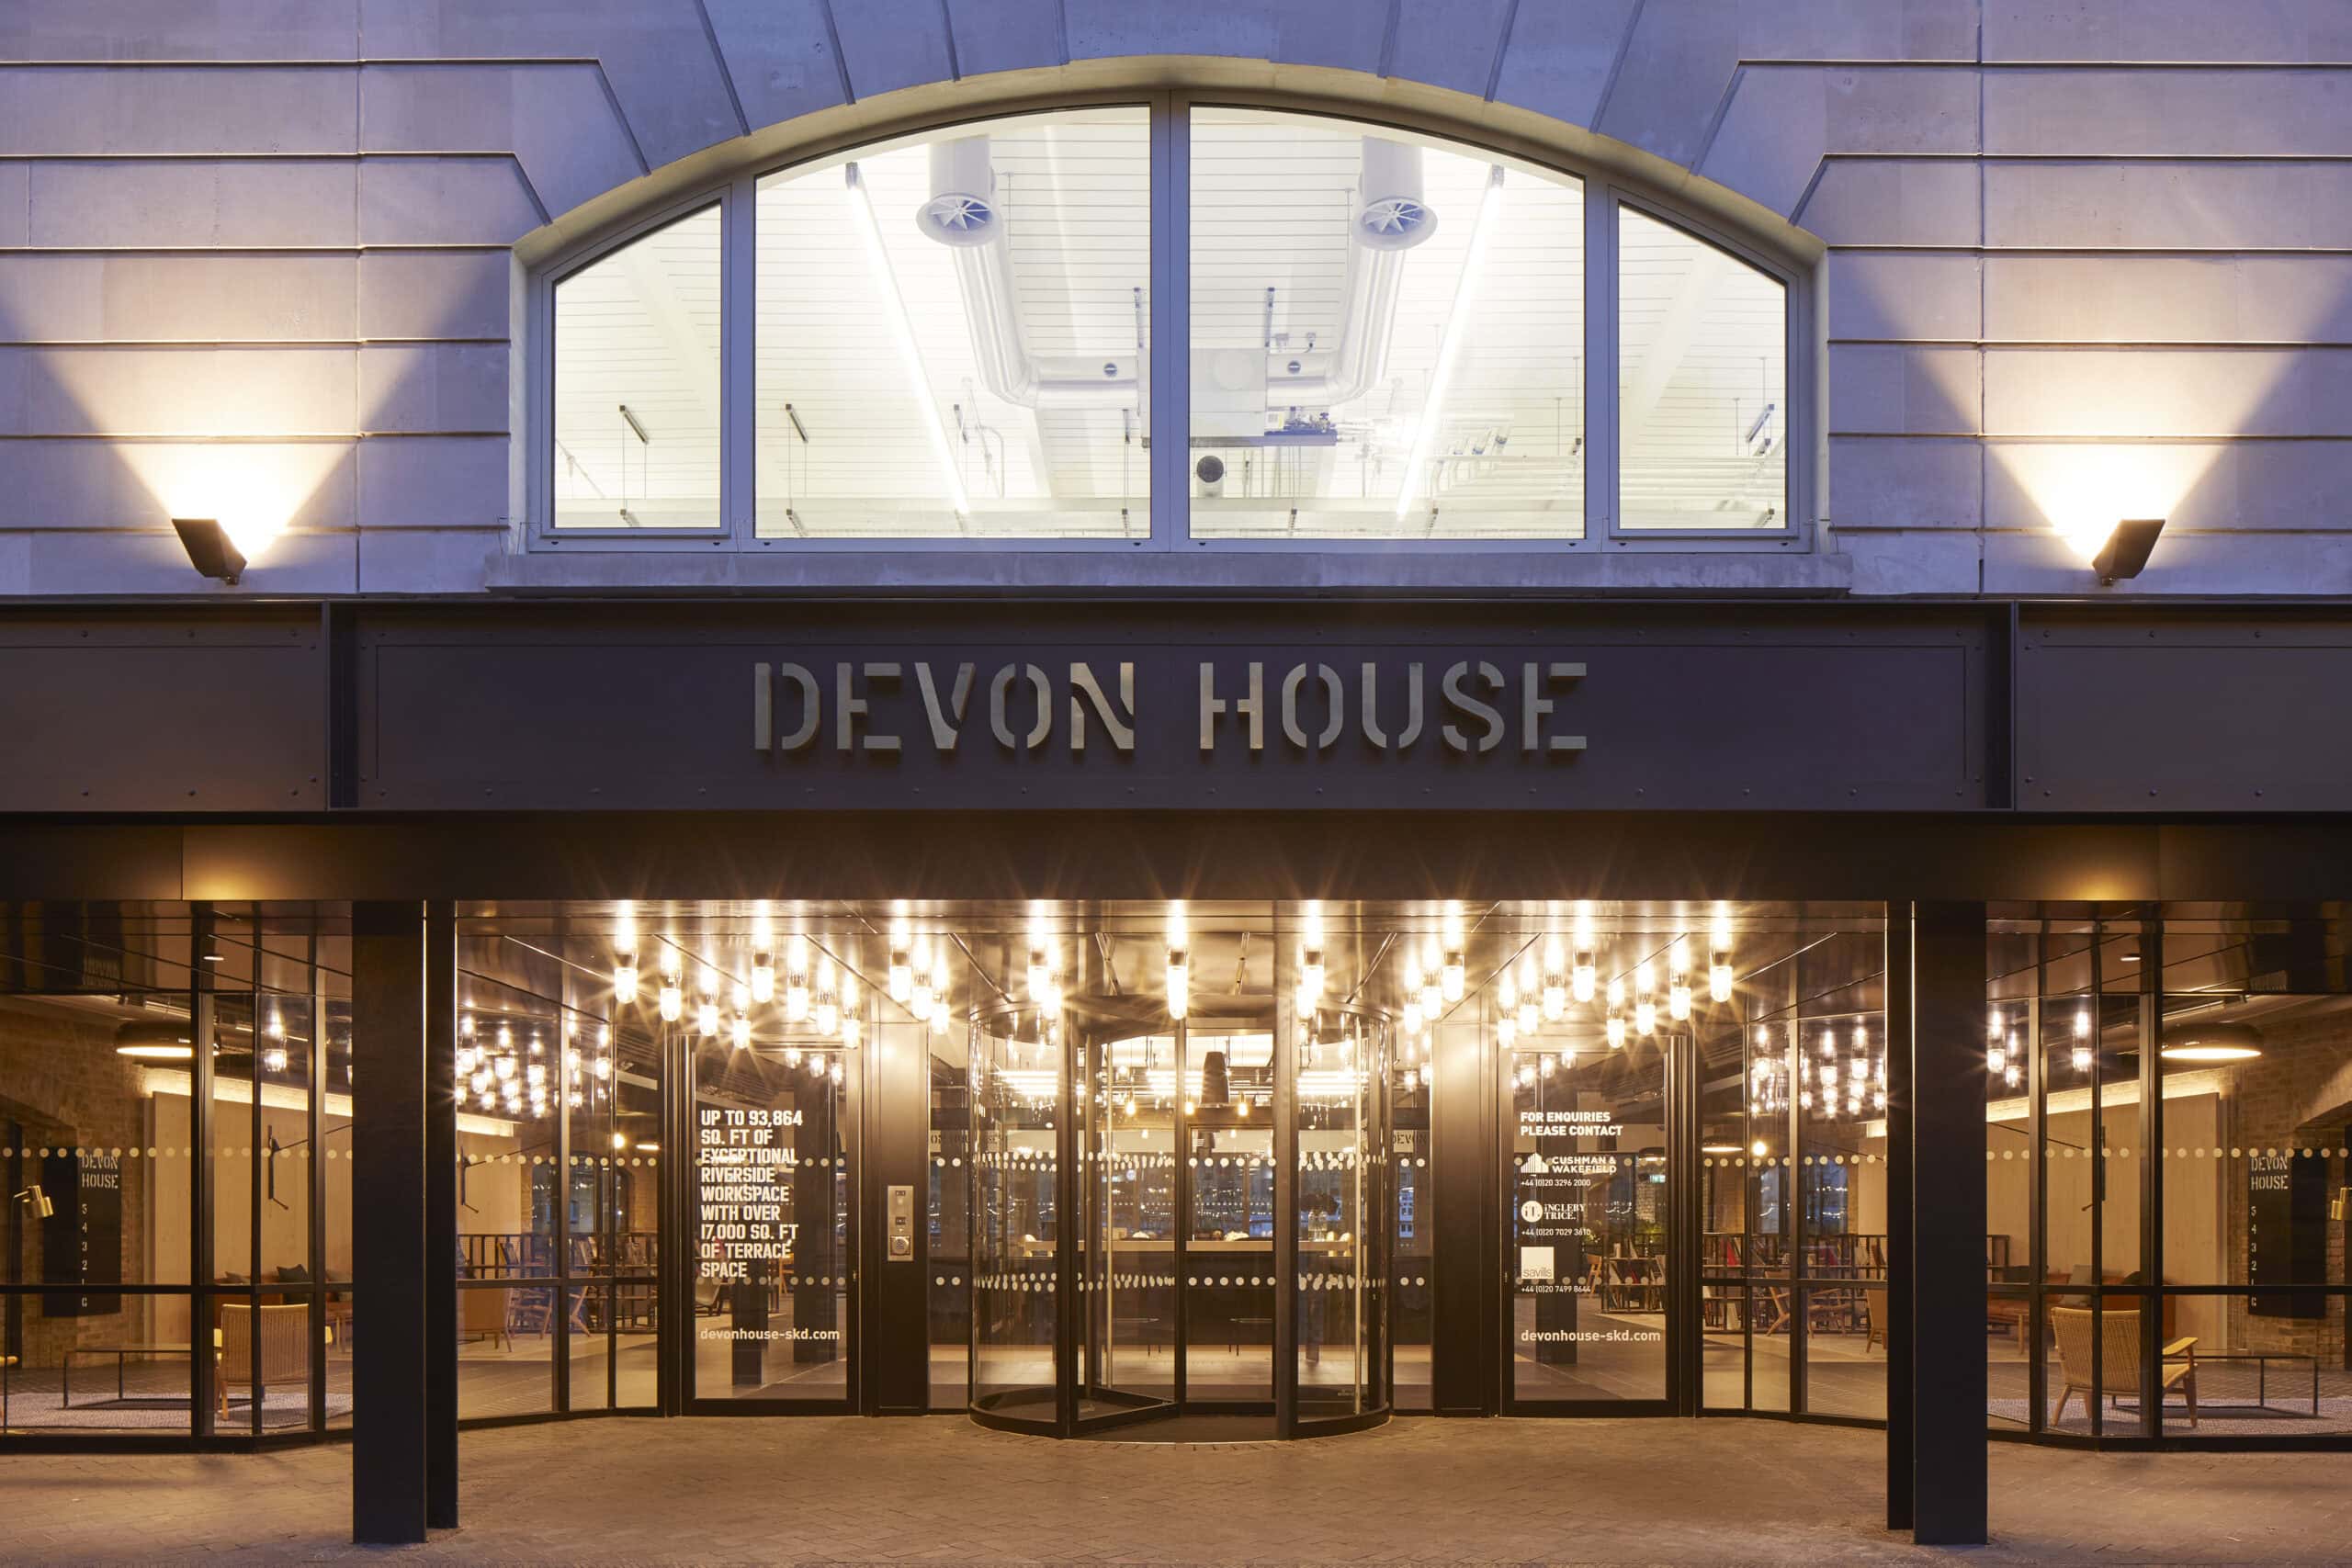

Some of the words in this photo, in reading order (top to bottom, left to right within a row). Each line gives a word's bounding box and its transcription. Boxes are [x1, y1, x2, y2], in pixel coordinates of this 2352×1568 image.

[752, 660, 1136, 752] DEVON
[1198, 660, 1589, 752] HOUSE
[701, 1110, 721, 1126] UP
[725, 1110, 745, 1126] TO
[749, 1110, 803, 1128] 93,864
[1521, 1111, 1544, 1122] FOR
[1546, 1111, 1611, 1123] ENQUIRIES
[701, 1129, 725, 1145] SQ.
[730, 1129, 750, 1145] FT
[753, 1129, 774, 1145] OF
[1521, 1125, 1566, 1136] PLEASE
[1569, 1125, 1623, 1136] CONTACT
[82, 1154, 119, 1169] DEVON
[701, 1148, 798, 1164] EXCEPTIONAL
[1552, 1156, 1606, 1165] CUSHMAN
[1609, 1156, 1617, 1165] &
[1552, 1165, 1617, 1174] WAKEFIELD
[2251, 1155, 2288, 1171] DEVON
[82, 1173, 119, 1189] HOUSE
[701, 1168, 775, 1183] RIVERSIDE
[2251, 1175, 2289, 1190] HOUSE
[701, 1186, 789, 1201] WORKSPACE
[82, 1204, 88, 1214] 5
[701, 1205, 739, 1221] WITH
[743, 1205, 780, 1221] OVER
[2251, 1206, 2256, 1217] 5
[82, 1223, 88, 1233] 4
[701, 1224, 746, 1241] 17,000
[751, 1224, 775, 1240] SQ.
[779, 1224, 798, 1240] FT
[2251, 1224, 2256, 1235] 4
[82, 1241, 88, 1251] 3
[701, 1243, 720, 1258] OF
[725, 1243, 791, 1258] TERRACE
[2251, 1243, 2256, 1252] 3
[82, 1259, 88, 1269] 2
[701, 1262, 747, 1278] SPACE
[2251, 1260, 2256, 1270] 2
[1522, 1268, 1552, 1278] savills
[700, 1328, 840, 1340] devonhouse-skd.com
[1521, 1329, 1661, 1342] devonhouse-skd.com
